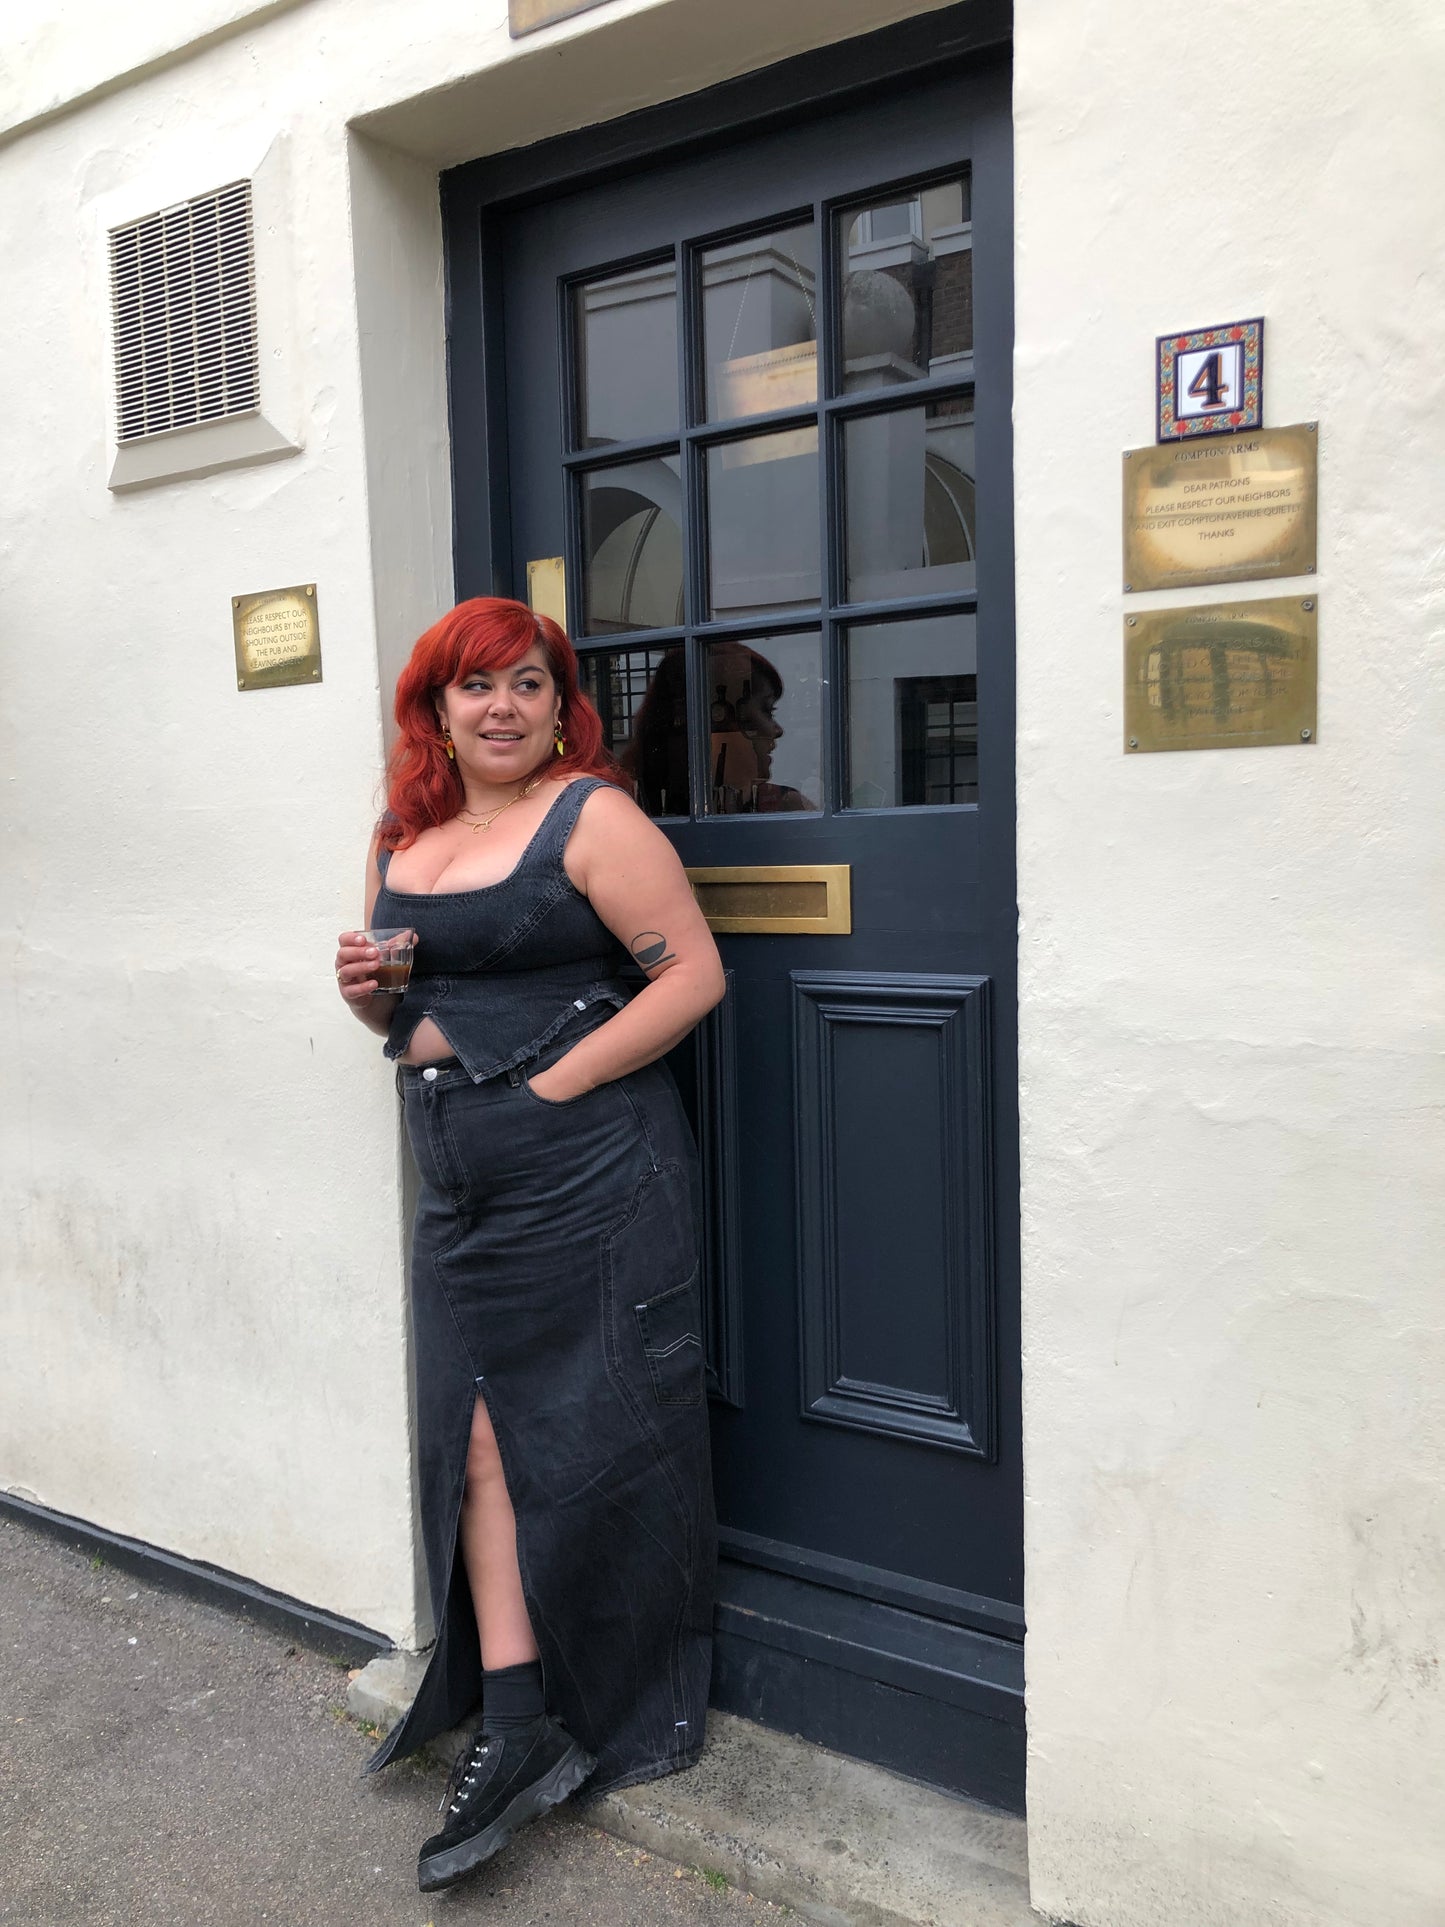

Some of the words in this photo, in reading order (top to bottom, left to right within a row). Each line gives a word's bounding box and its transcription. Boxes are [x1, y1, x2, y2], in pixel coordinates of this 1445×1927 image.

[1188, 352, 1229, 410] 4
[1174, 447, 1224, 462] COMPTON
[1228, 441, 1260, 455] ARMS
[1184, 483, 1207, 494] DEAR
[1208, 477, 1250, 490] PATRONS
[1146, 502, 1175, 514] PLEASE
[1176, 498, 1214, 512] RESPECT
[1215, 496, 1236, 506] OUR
[1237, 488, 1290, 504] NEIGHBORS
[1136, 521, 1155, 531] AND
[1157, 519, 1176, 529] EXIT
[1178, 512, 1224, 527] COMPTON
[1224, 508, 1262, 522] AVENUE
[1198, 528, 1235, 541] THANKS
[265, 610, 291, 622] RESPECT
[292, 608, 307, 618] OUR
[284, 622, 292, 631] BY
[293, 620, 308, 630] NOT
[246, 635, 278, 648] SHOUTING
[280, 632, 307, 644] OUTSIDE
[256, 648, 268, 657] THE
[270, 646, 281, 656] PUB
[282, 644, 298, 654] AND
